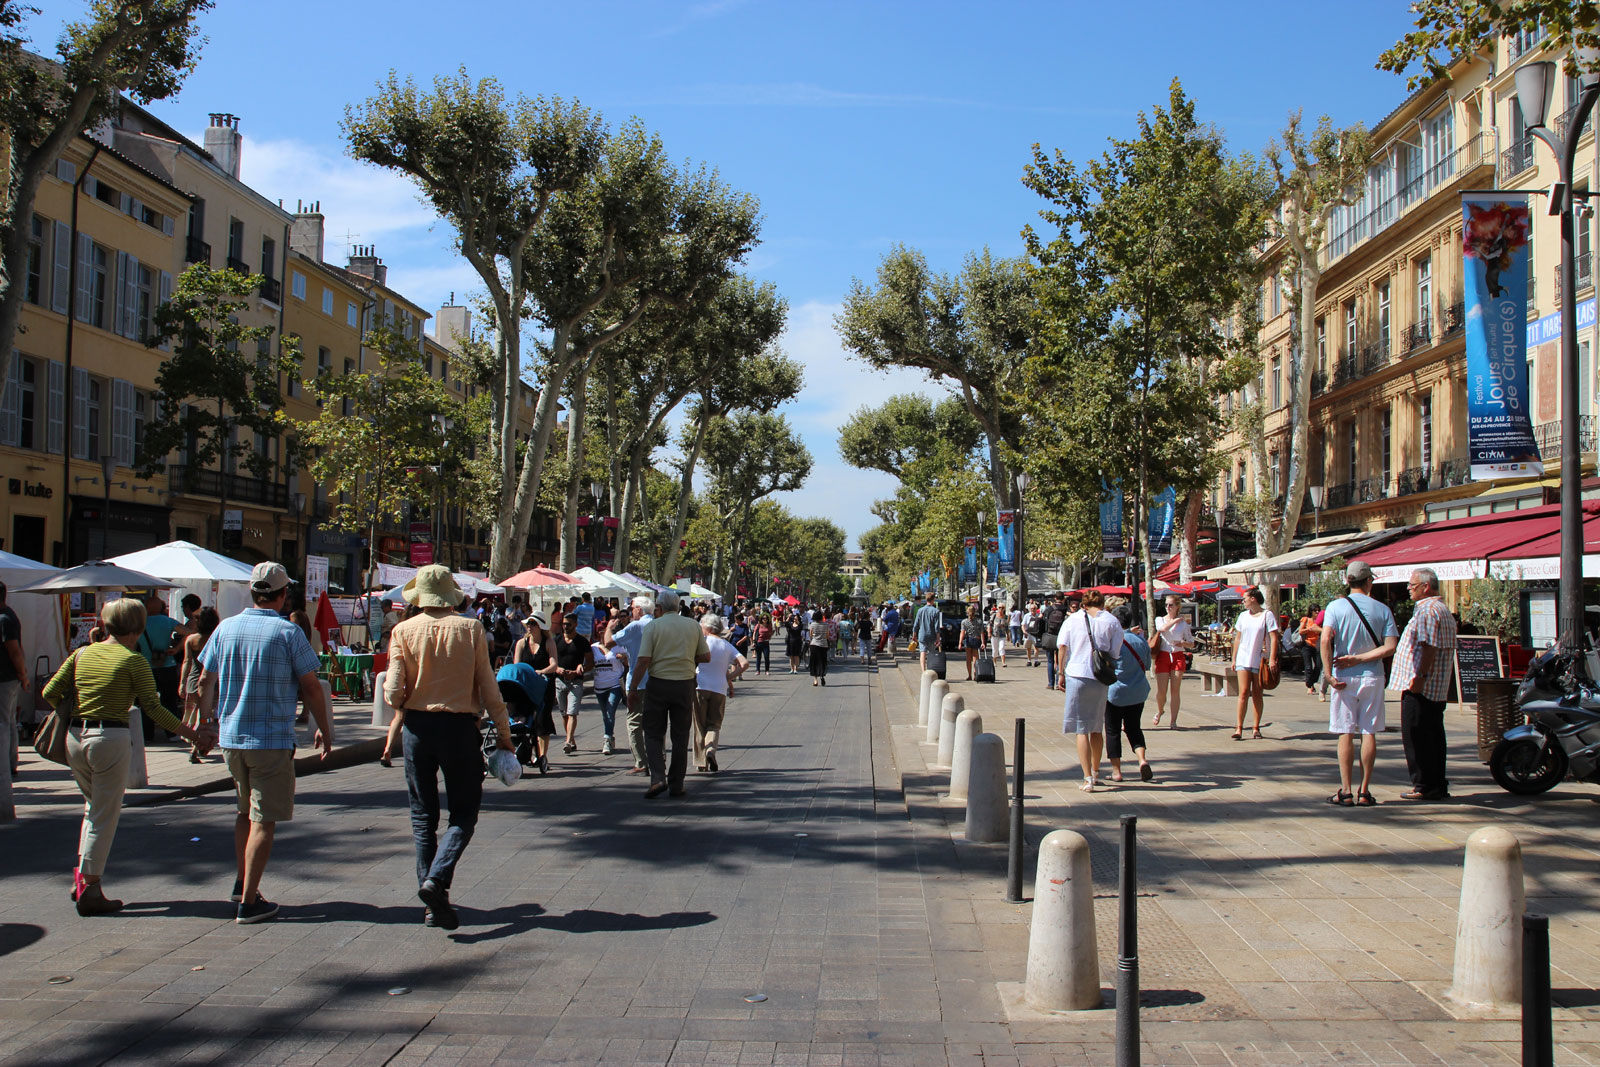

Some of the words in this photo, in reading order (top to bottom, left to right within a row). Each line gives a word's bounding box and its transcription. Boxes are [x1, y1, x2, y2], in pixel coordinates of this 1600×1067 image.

[1500, 300, 1517, 381] Cirque(s)
[1475, 375, 1484, 405] Festival
[1487, 362, 1505, 408] Jours
[1507, 385, 1519, 410] de
[24, 480, 53, 498] kulte
